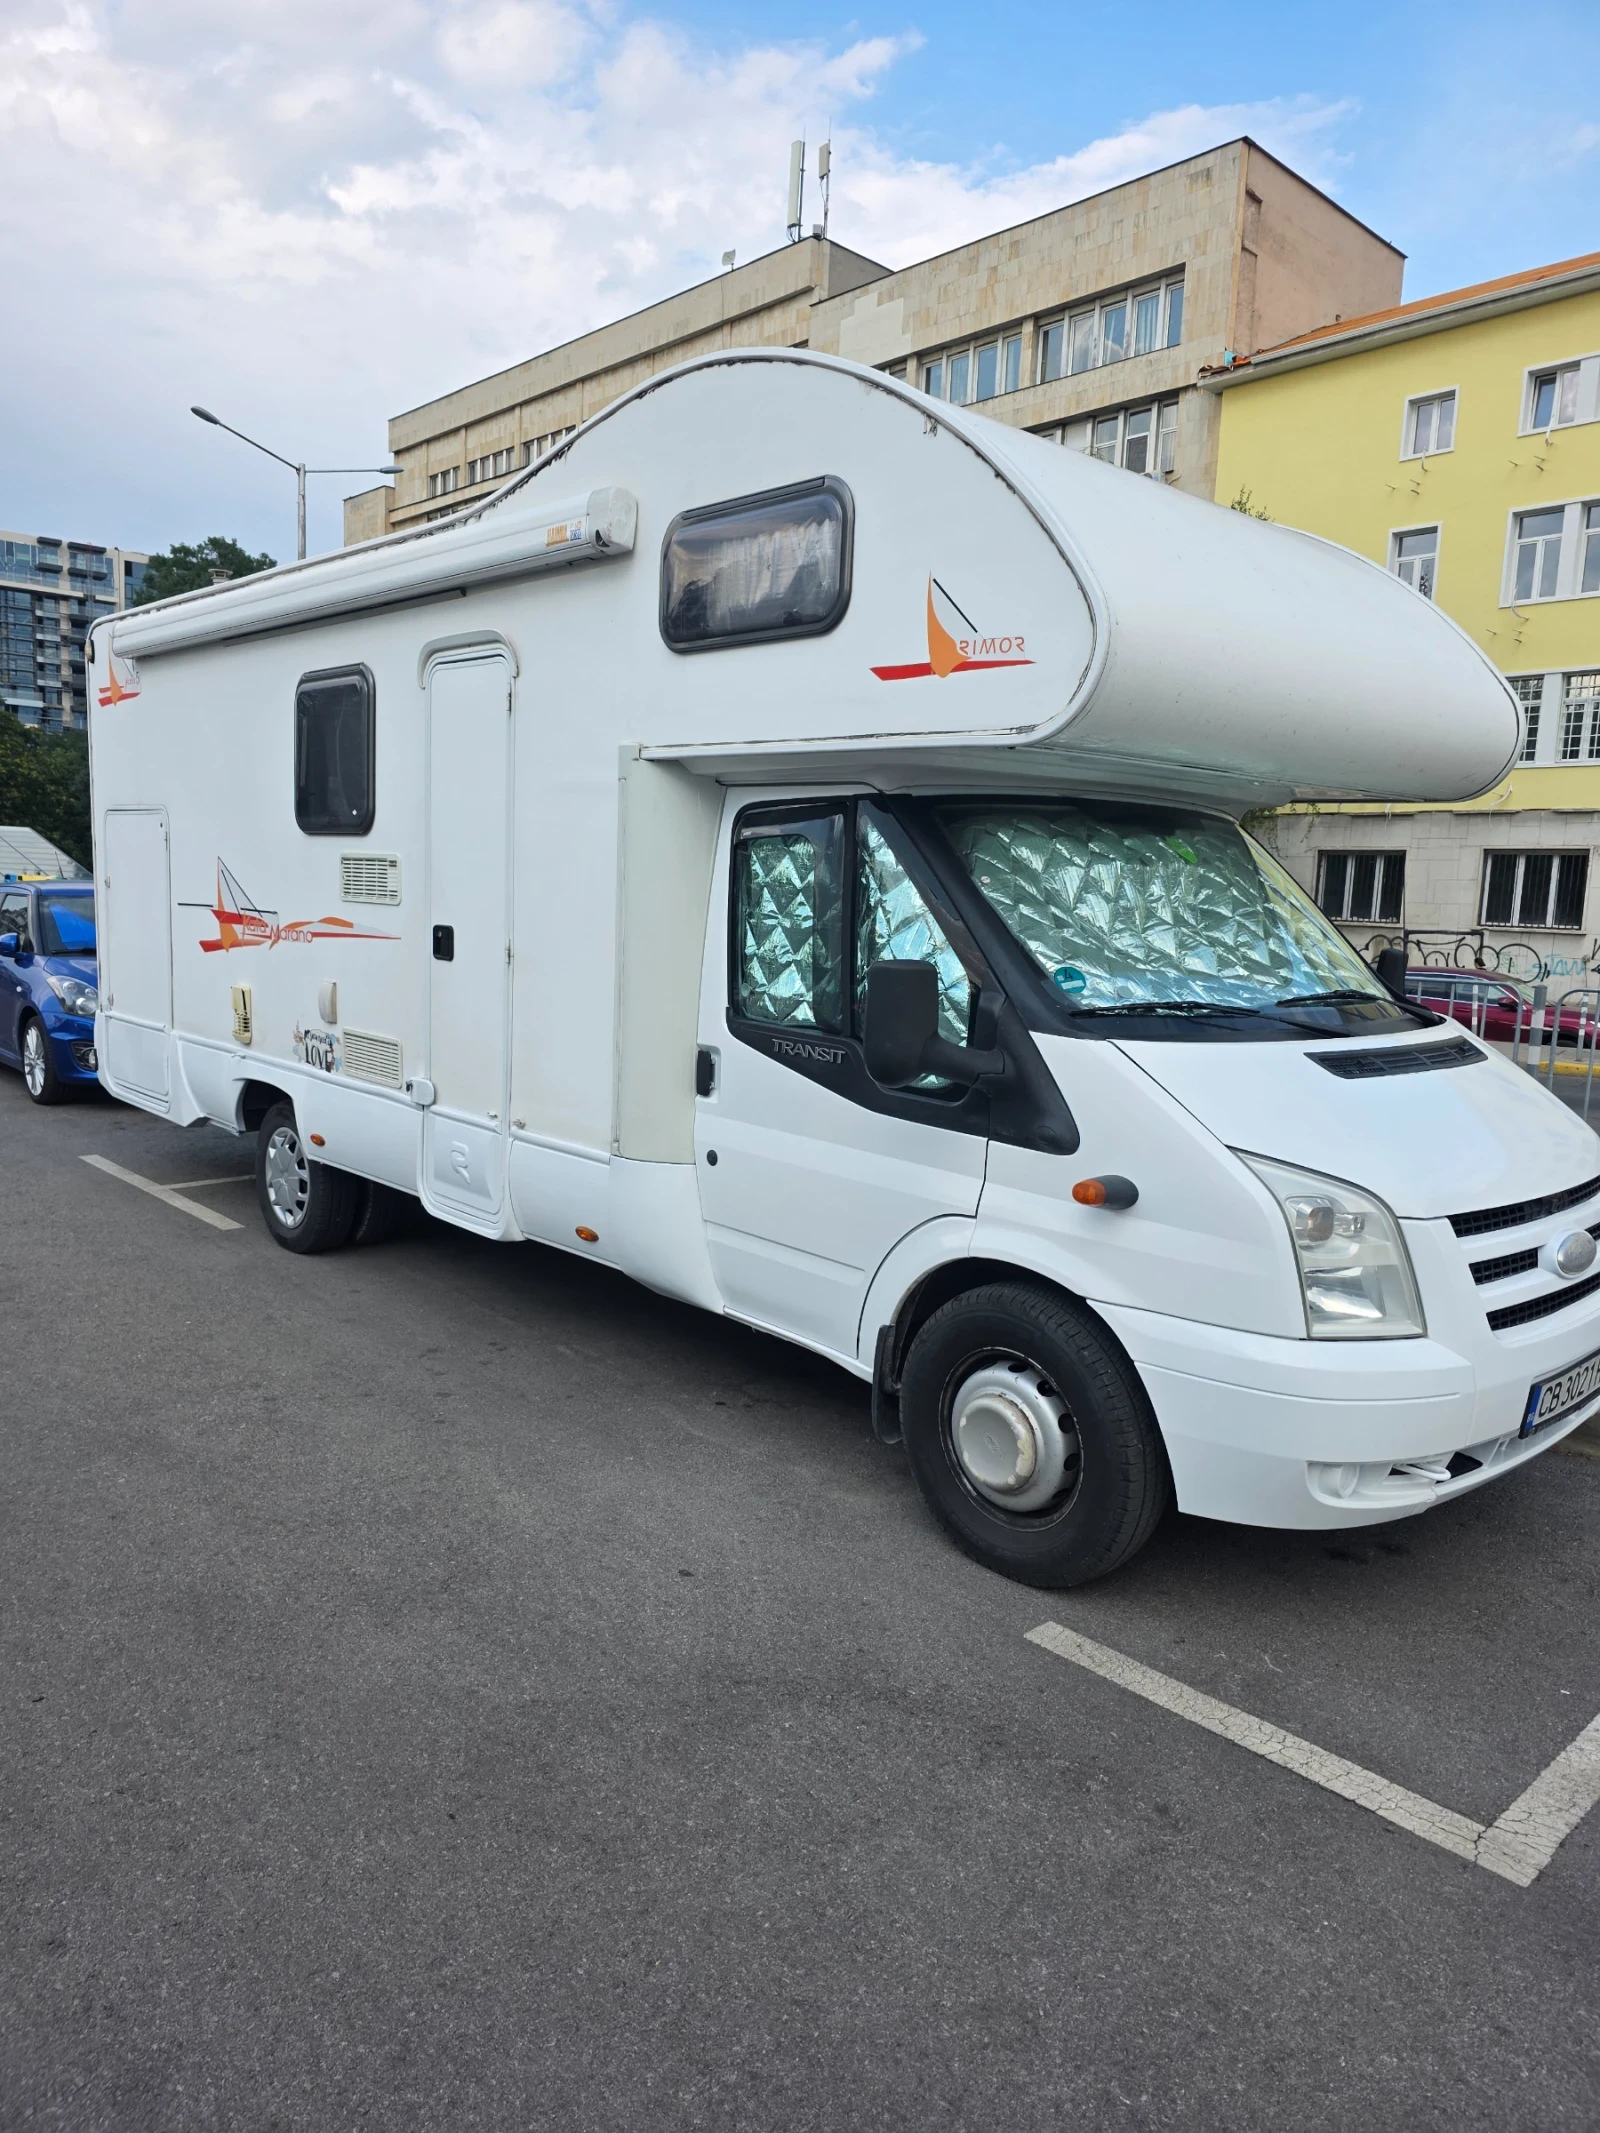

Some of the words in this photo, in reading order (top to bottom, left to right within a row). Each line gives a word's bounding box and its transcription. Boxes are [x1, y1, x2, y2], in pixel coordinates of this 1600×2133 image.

[959, 636, 1025, 655] RIMOR
[269, 924, 314, 945] Marano
[1064, 968, 1074, 980] 4
[305, 1041, 333, 1073] LOVE
[771, 1038, 847, 1064] TRANSIT
